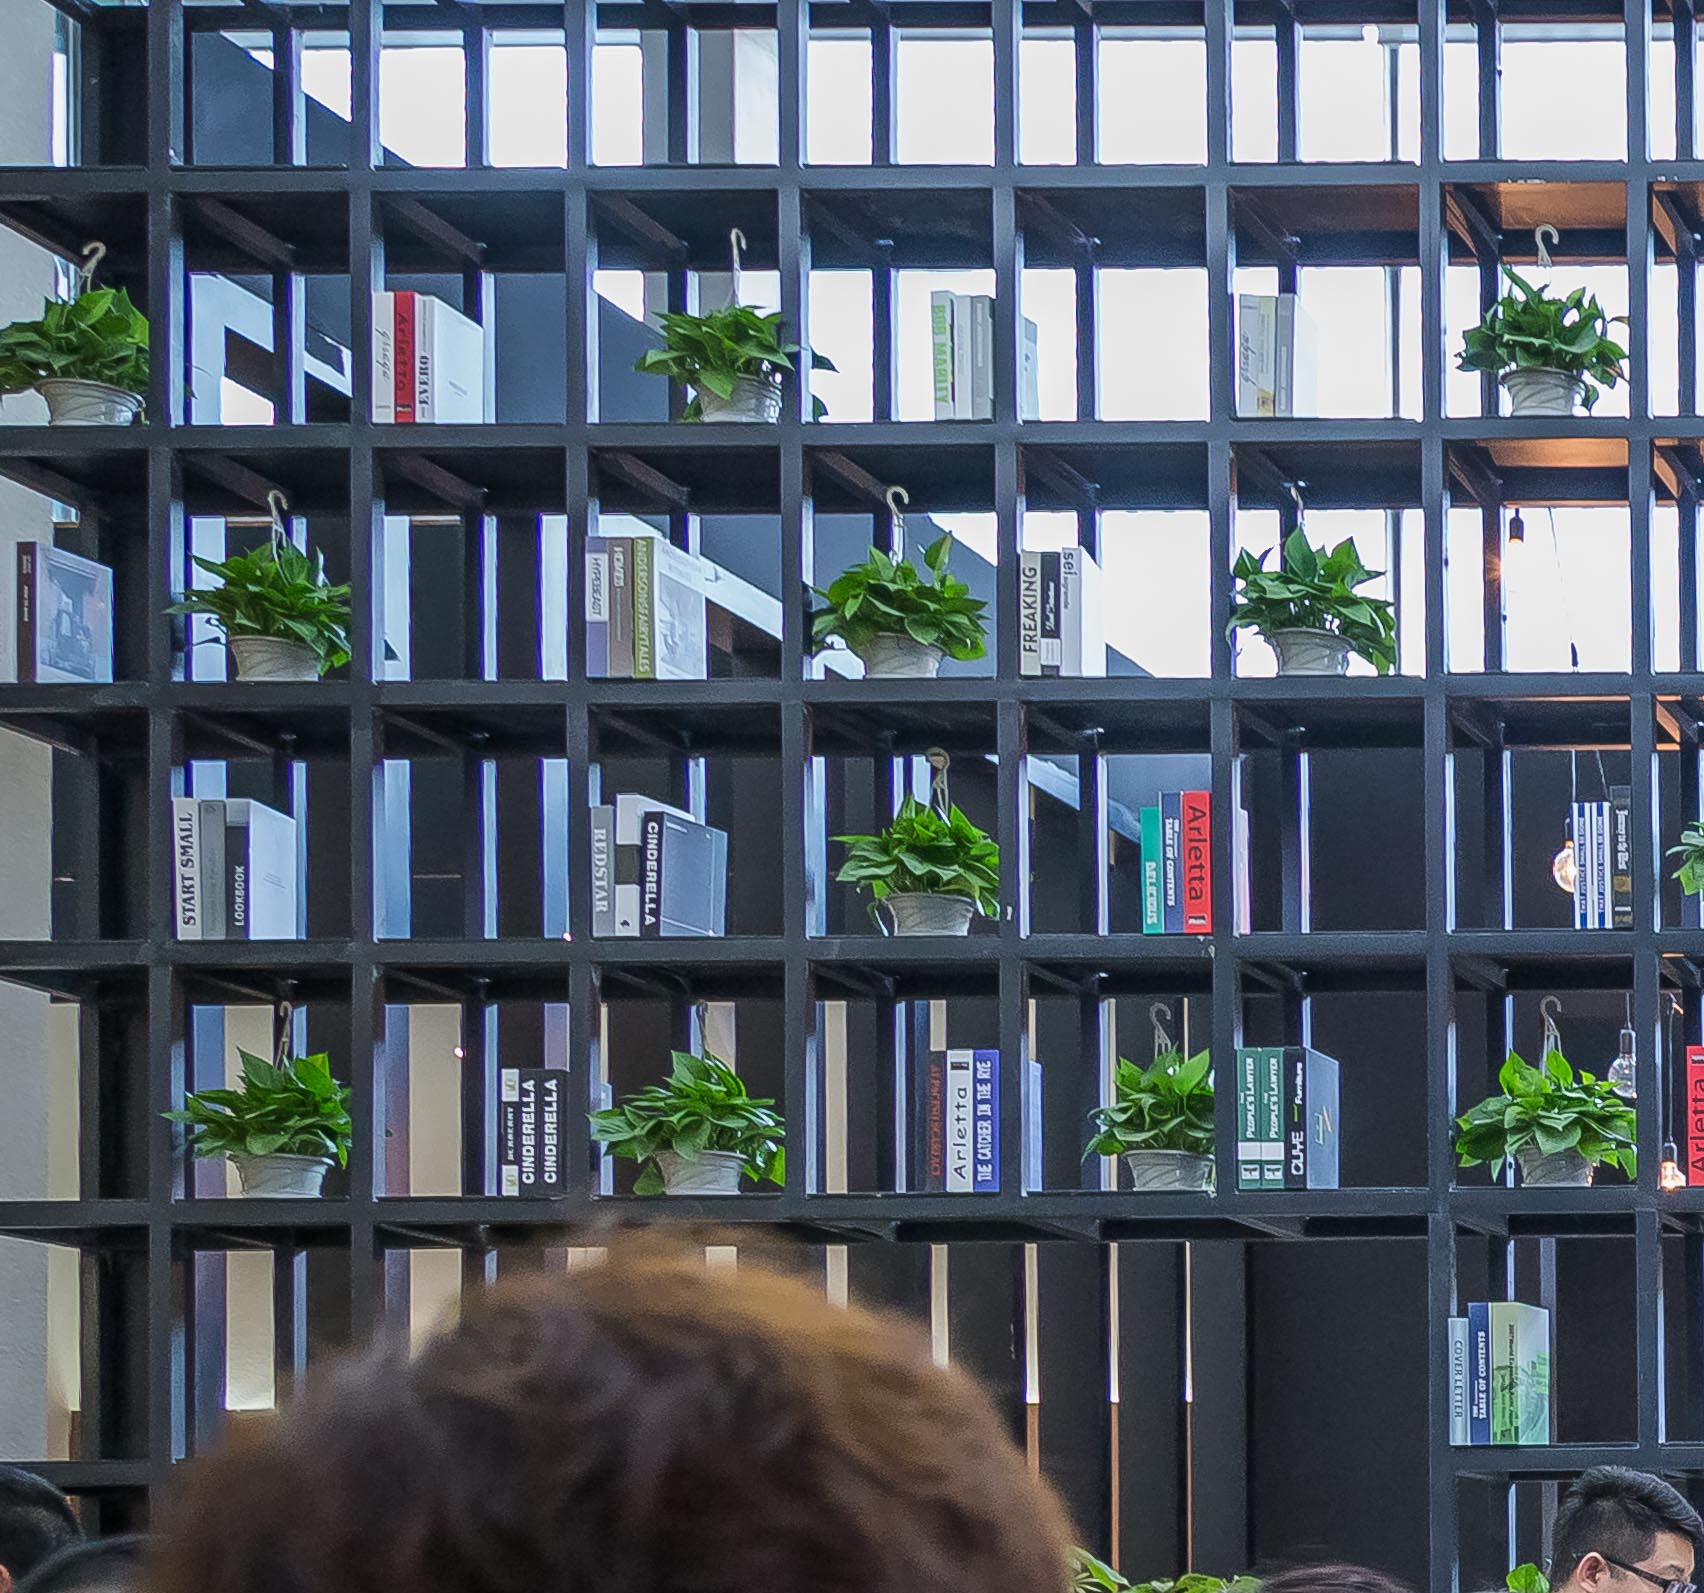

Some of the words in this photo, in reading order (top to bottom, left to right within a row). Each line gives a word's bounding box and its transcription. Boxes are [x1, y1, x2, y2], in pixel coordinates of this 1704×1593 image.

[591, 557, 602, 617] HYPEBEAST
[1022, 567, 1037, 652] FREAKING
[180, 812, 195, 871] SMALL
[595, 828, 608, 913] REDSTAR
[1187, 805, 1208, 901] Arletta
[182, 874, 197, 926] START
[234, 865, 246, 926] LOOKBOOK
[645, 822, 660, 926] CINDERELLA
[977, 1082, 991, 1099] THE
[977, 1103, 991, 1117] IN
[522, 1080, 535, 1184] CINDERELLA
[544, 1079, 558, 1184] CINDERELLA
[953, 1087, 967, 1180] Arletta
[978, 1163, 992, 1182] THE
[1453, 1340, 1464, 1373] COVER
[1478, 1331, 1488, 1378] CONTENTS
[1454, 1374, 1465, 1418] LETTER
[1478, 1380, 1487, 1391] OF
[1479, 1393, 1488, 1419] TABLE
